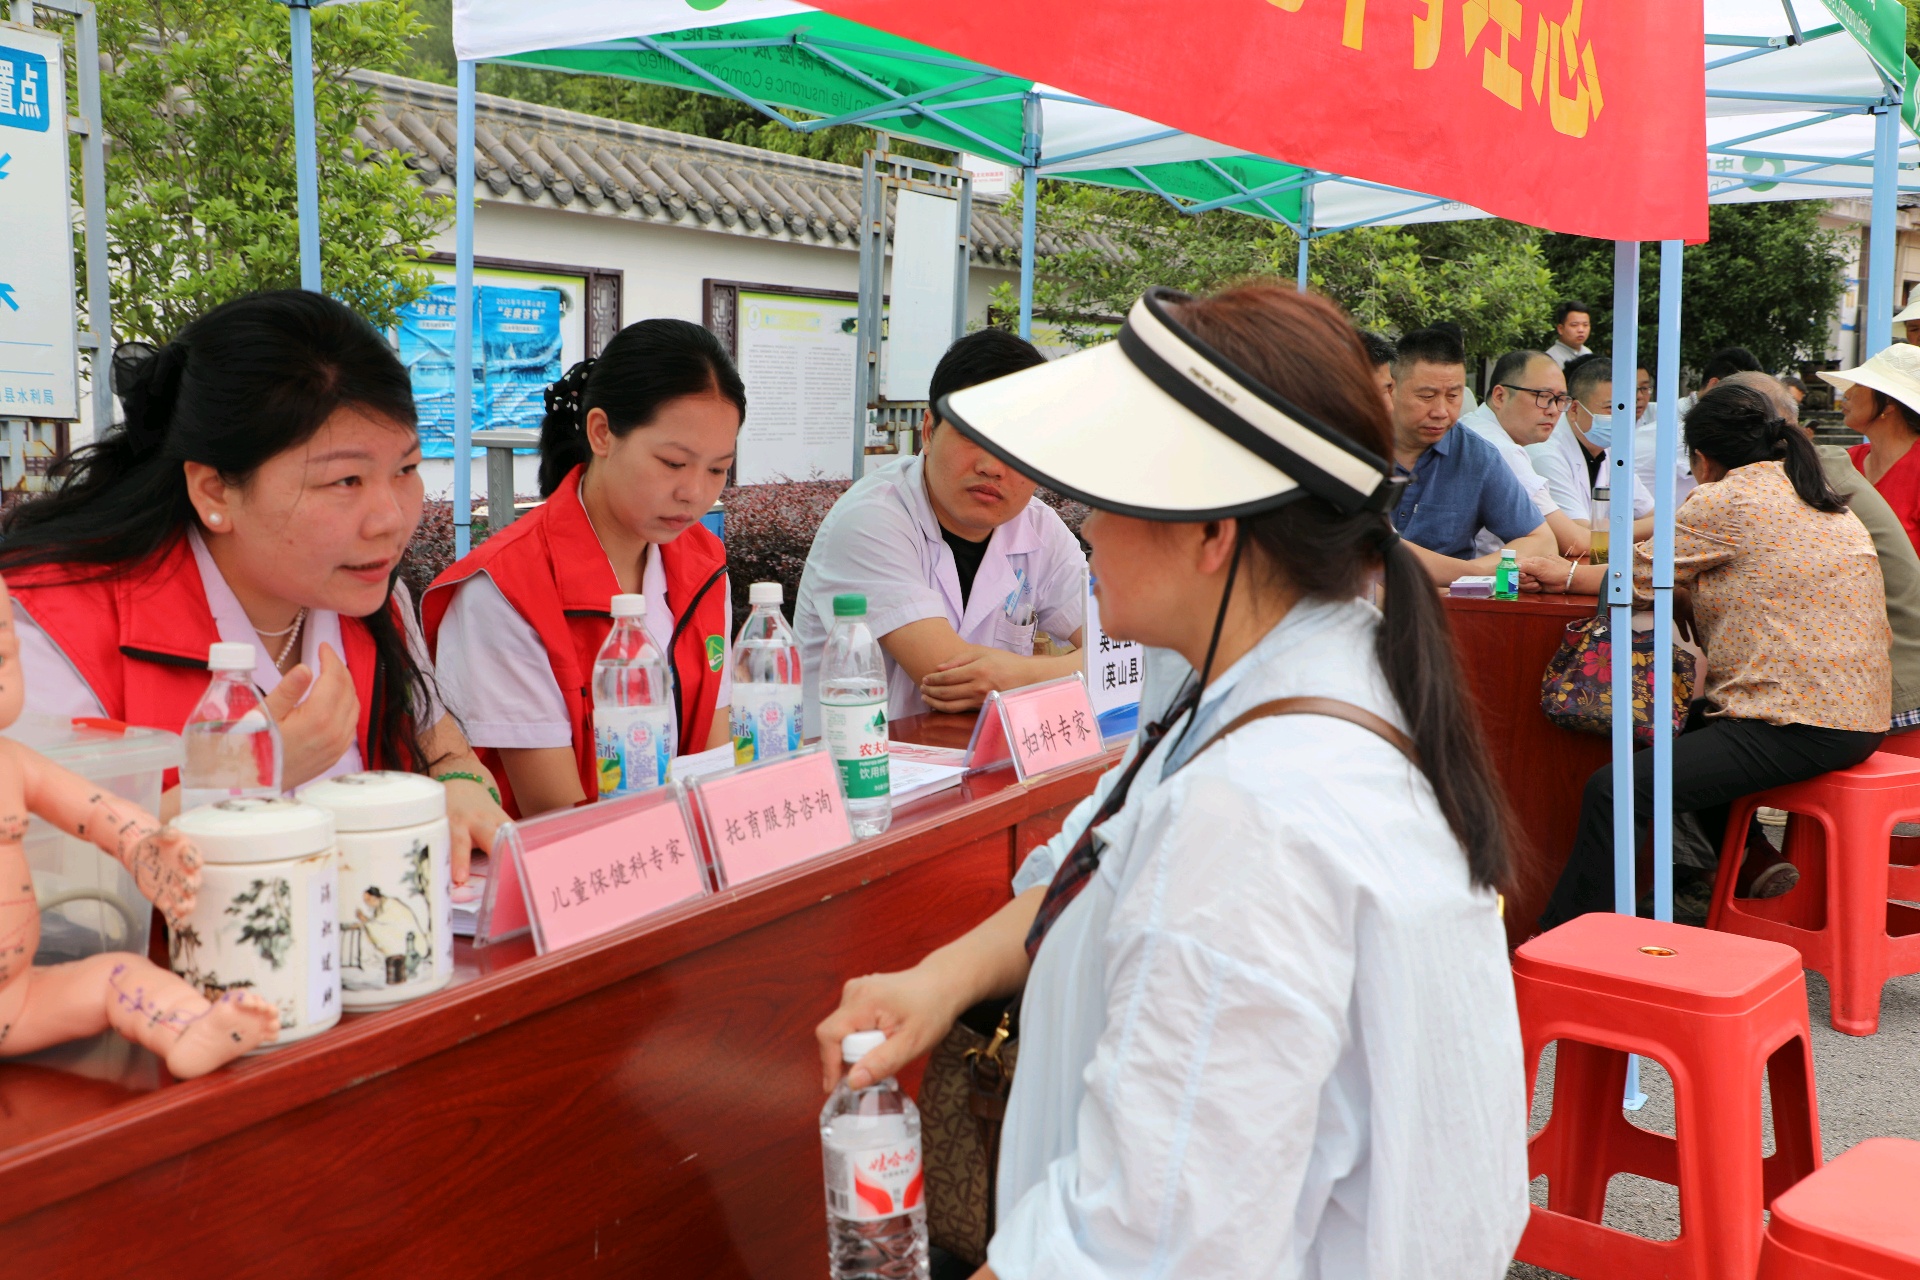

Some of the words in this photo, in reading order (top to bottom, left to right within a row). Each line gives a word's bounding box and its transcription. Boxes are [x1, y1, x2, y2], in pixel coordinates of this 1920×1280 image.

[0, 59, 41, 119] 置点
[0, 387, 54, 405] 县水利局
[1022, 709, 1091, 758] 妇科专家
[859, 764, 889, 780] 饮用纯
[725, 788, 833, 845] 托育服务咨询
[551, 838, 686, 912] 儿童保健科专家
[869, 1146, 917, 1172] 娃哈哈
